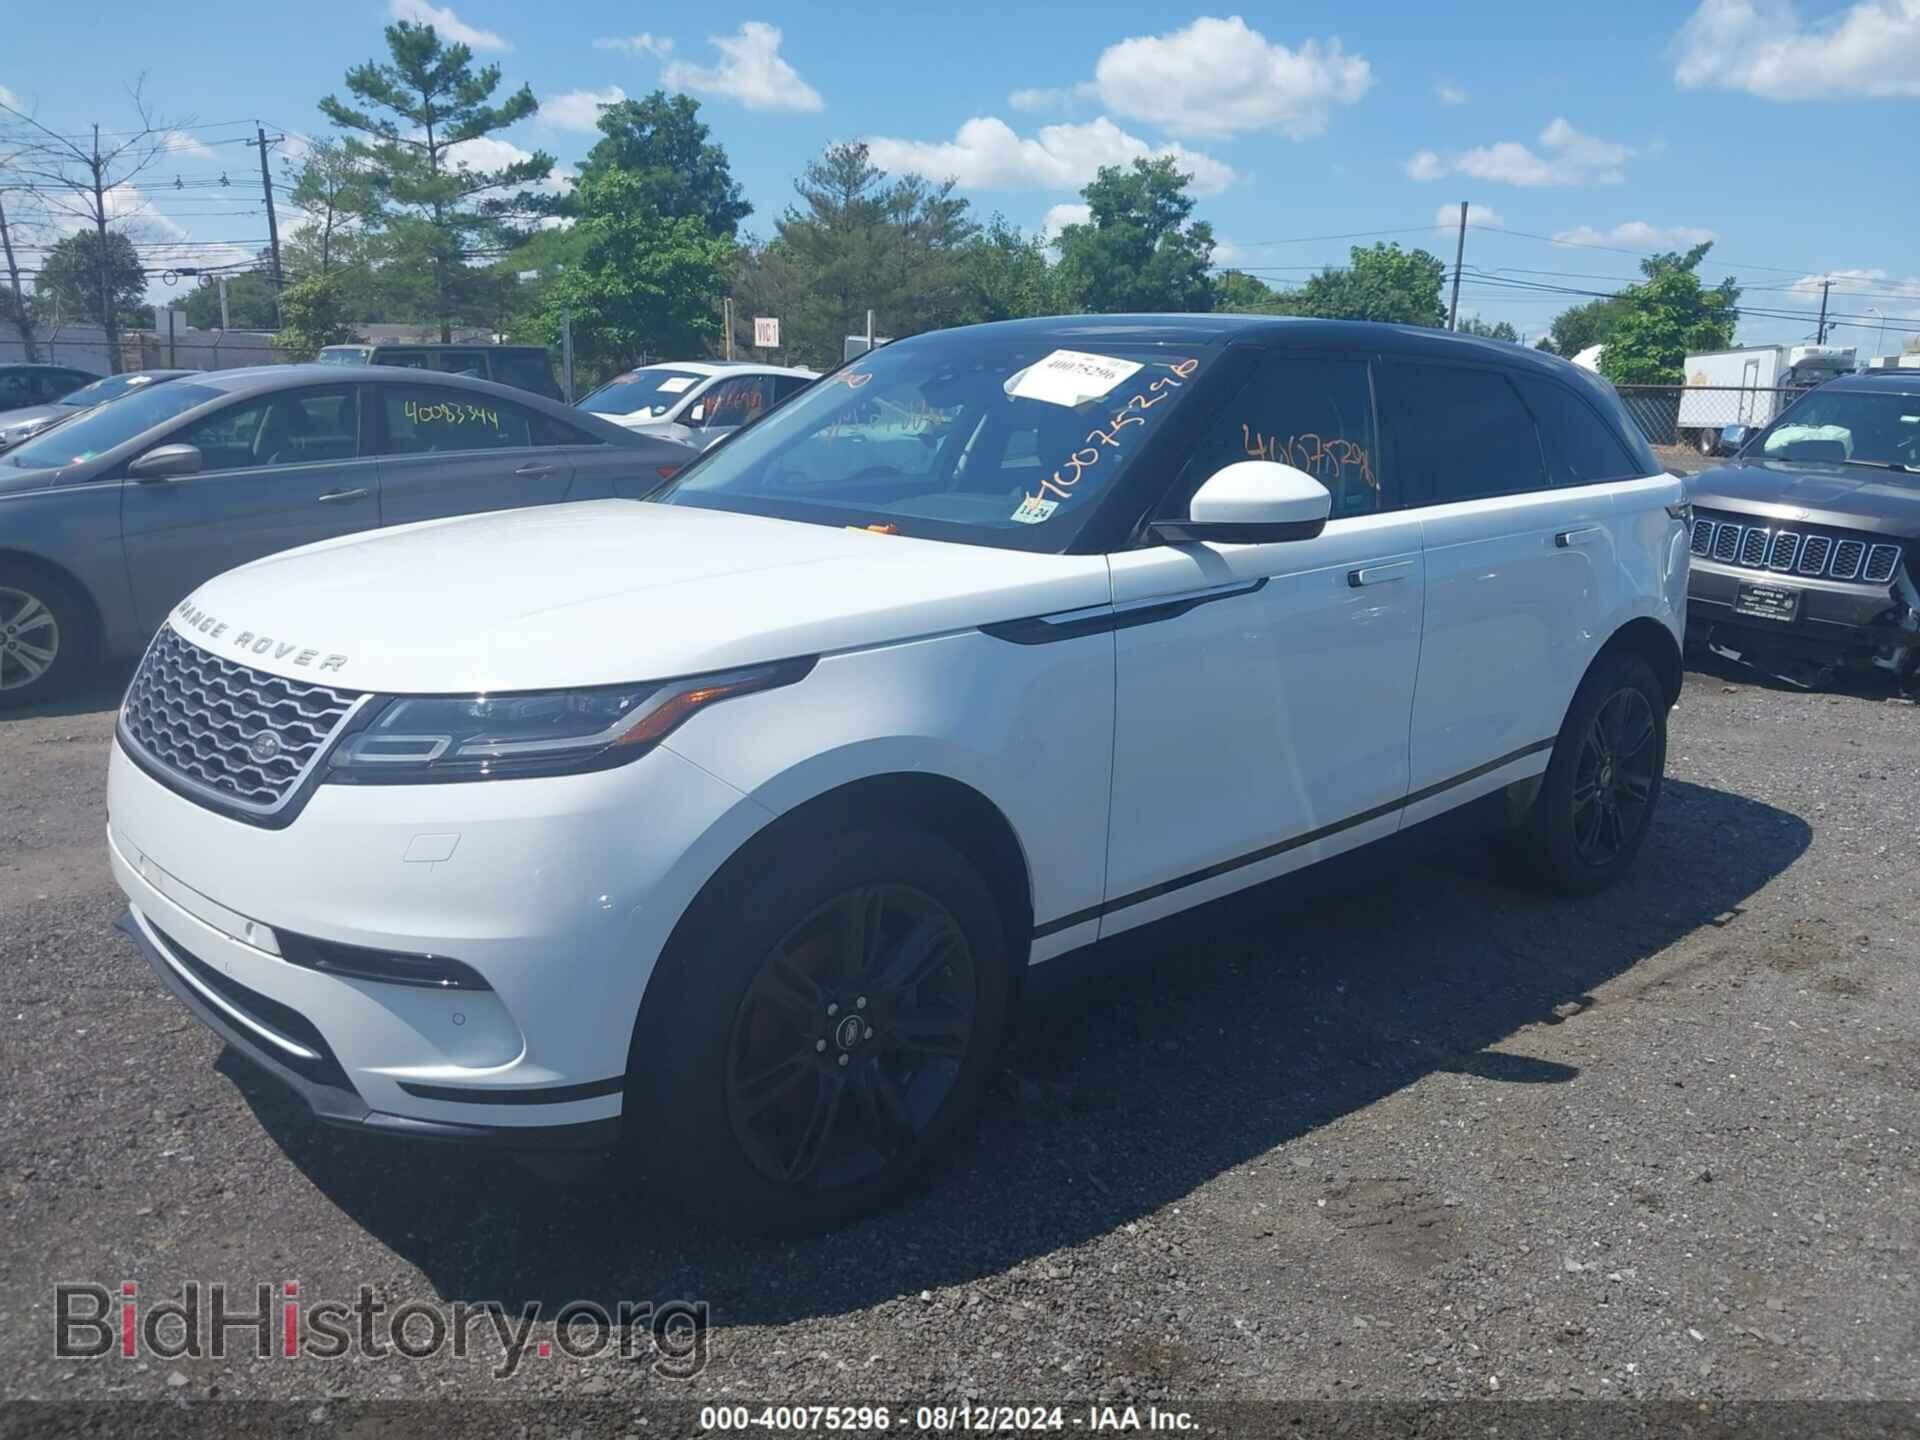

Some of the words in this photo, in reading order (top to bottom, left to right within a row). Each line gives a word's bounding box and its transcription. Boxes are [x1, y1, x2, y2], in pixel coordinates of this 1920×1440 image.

[405, 401, 498, 431] 40083344
[1025, 359, 1199, 512] 40075296
[178, 600, 229, 638] RANGE
[233, 631, 348, 672] ROVER
